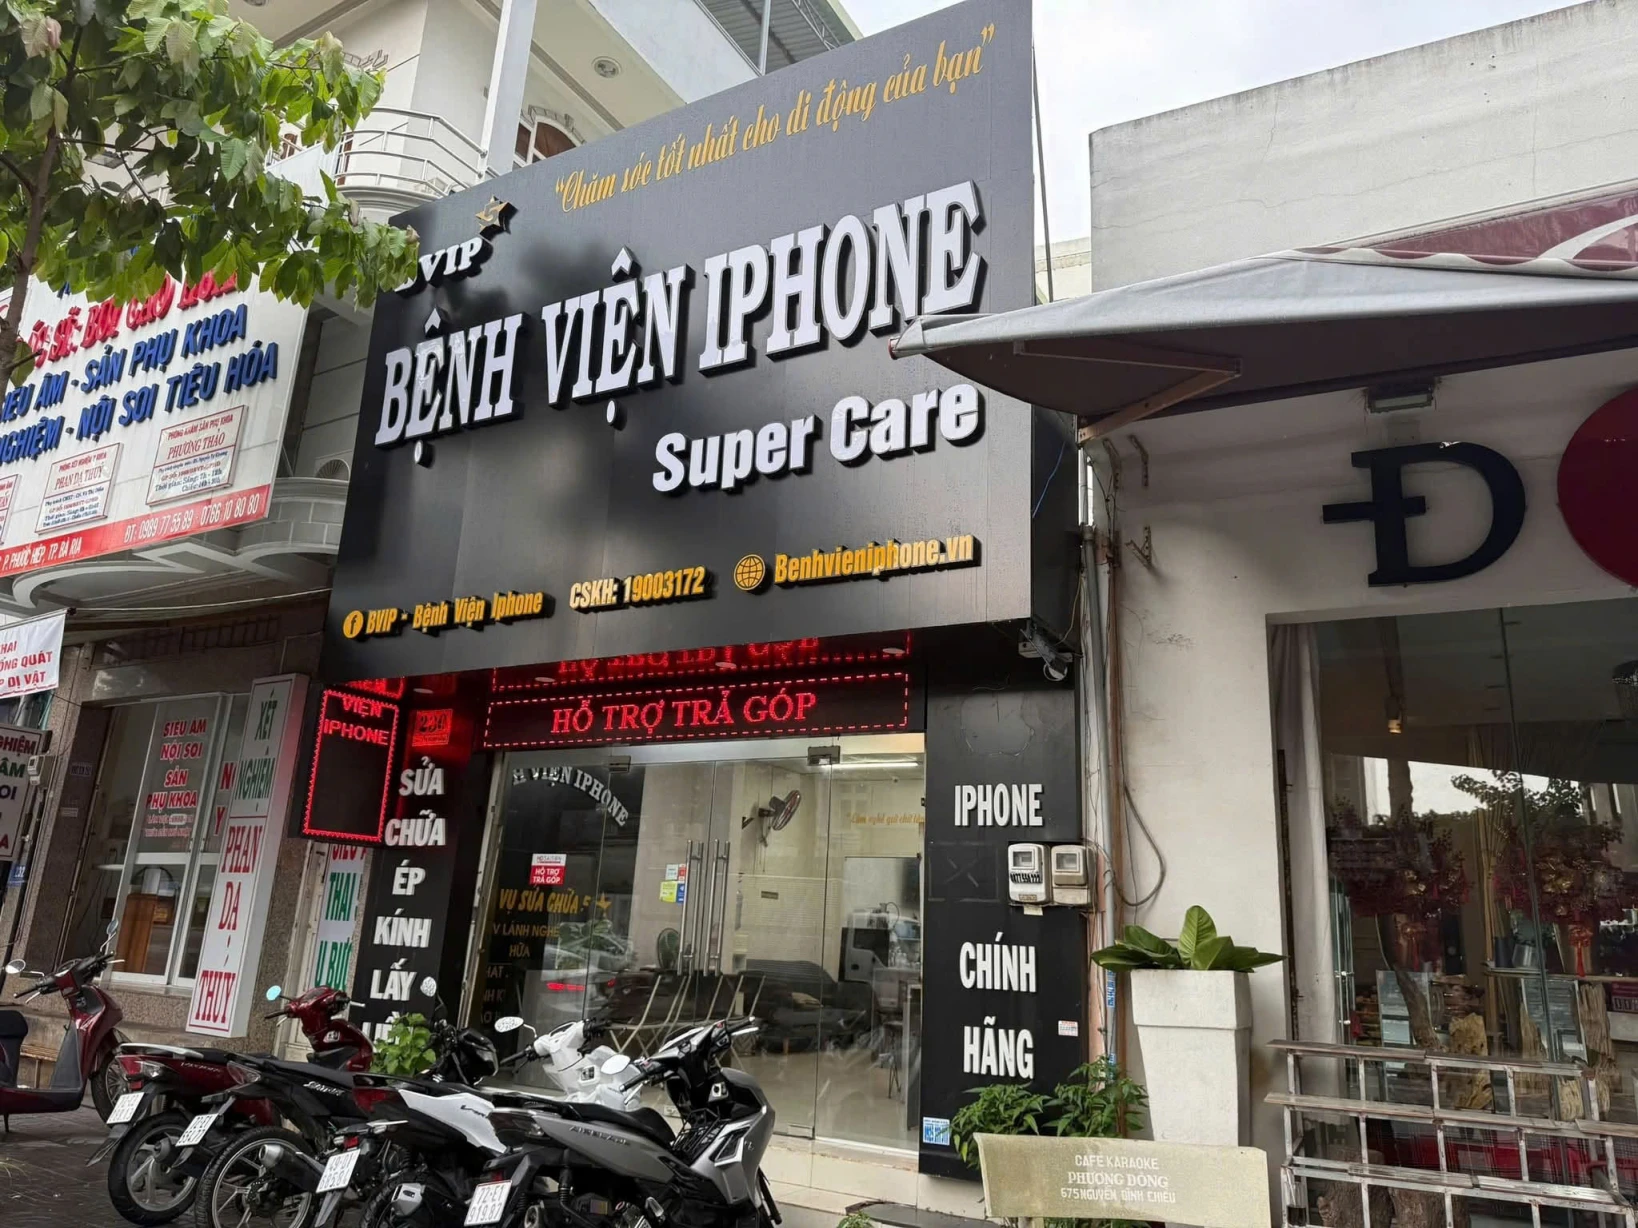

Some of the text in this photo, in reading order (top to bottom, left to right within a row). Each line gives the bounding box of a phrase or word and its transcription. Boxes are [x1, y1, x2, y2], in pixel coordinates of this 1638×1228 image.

[656, 133, 687, 180] tốt
[687, 115, 739, 169] nhất
[742, 104, 781, 150] cho
[786, 89, 812, 135] di
[815, 78, 877, 132] động
[883, 53, 928, 102] của
[394, 236, 484, 292] VIP
[128, 328, 179, 377] PHỤ
[180, 303, 248, 360] KHOA
[375, 180, 980, 465] BỆNH VIỆN IPHONE
[76, 394, 117, 442] NỘI
[118, 383, 159, 427] SOI
[164, 362, 221, 413] TIÊU
[223, 339, 279, 393] HÓA
[653, 383, 978, 492] Super Care
[774, 534, 974, 584] Benhvieniphone.vn
[569, 565, 706, 610] CSKH: 19003172
[366, 591, 544, 634] BVIP Bệnh Viện Iphone
[24, 670, 47, 686] VẬT
[323, 718, 390, 746] IPHONE
[550, 687, 818, 735] HỖ TRỢ TRẢ GÓP
[398, 755, 446, 796] SỬA
[573, 769, 629, 827] IPHONE
[384, 808, 446, 847] CHỮA
[954, 783, 1043, 827] IPHONE
[220, 824, 263, 873] PHAN
[391, 858, 426, 896] ÉP
[373, 907, 433, 948] KÍNH
[369, 957, 418, 1001] LẤY
[959, 931, 1037, 993] CHÍNH
[963, 1016, 1035, 1079] HÃNG
[1105, 1156, 1161, 1170] KARAOKE
